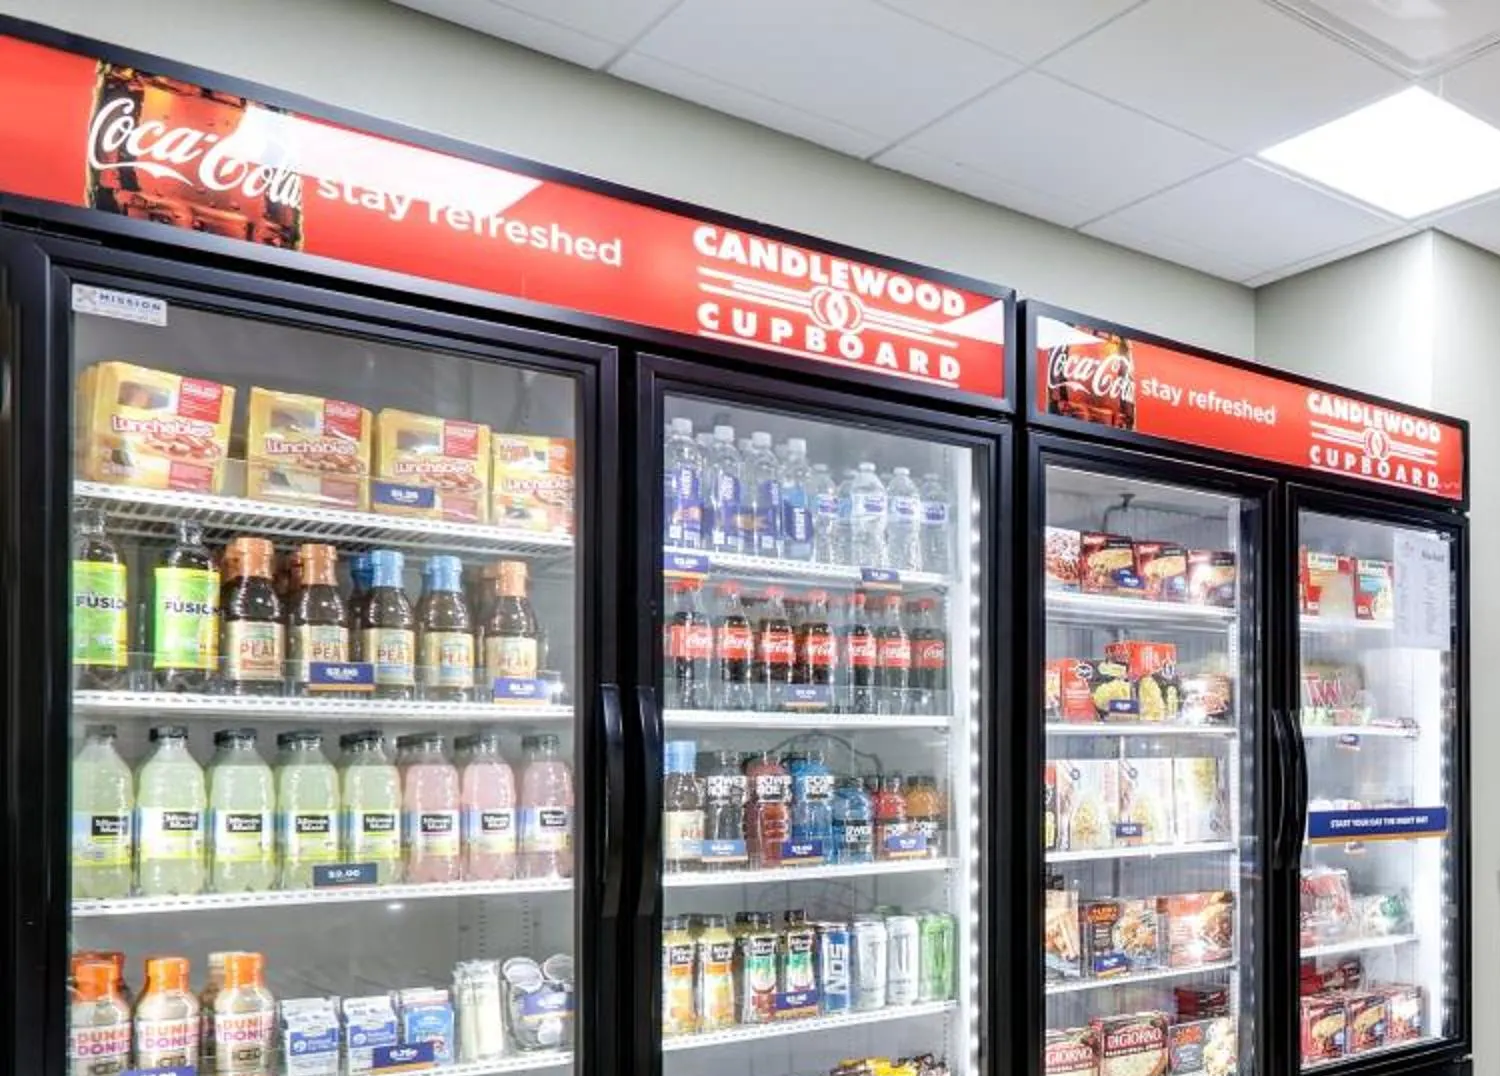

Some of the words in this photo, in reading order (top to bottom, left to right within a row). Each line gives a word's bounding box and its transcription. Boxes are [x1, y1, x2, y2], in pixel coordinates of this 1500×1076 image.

[89, 97, 303, 211] Coca-Cola
[317, 173, 411, 219] stay
[427, 192, 622, 267] refreshed
[693, 226, 965, 317] CANDLEWOOD
[697, 303, 960, 380] CUPBOARD
[1049, 345, 1136, 401] Coca-Cola
[112, 415, 216, 438] Lunchables
[1140, 377, 1183, 408] stay
[1188, 390, 1277, 426] refreshed
[1307, 394, 1440, 443] CANDLEWOOD
[264, 437, 359, 457] Lunchables
[1310, 447, 1440, 490] CUPBOARD
[825, 943, 848, 996] NOS
